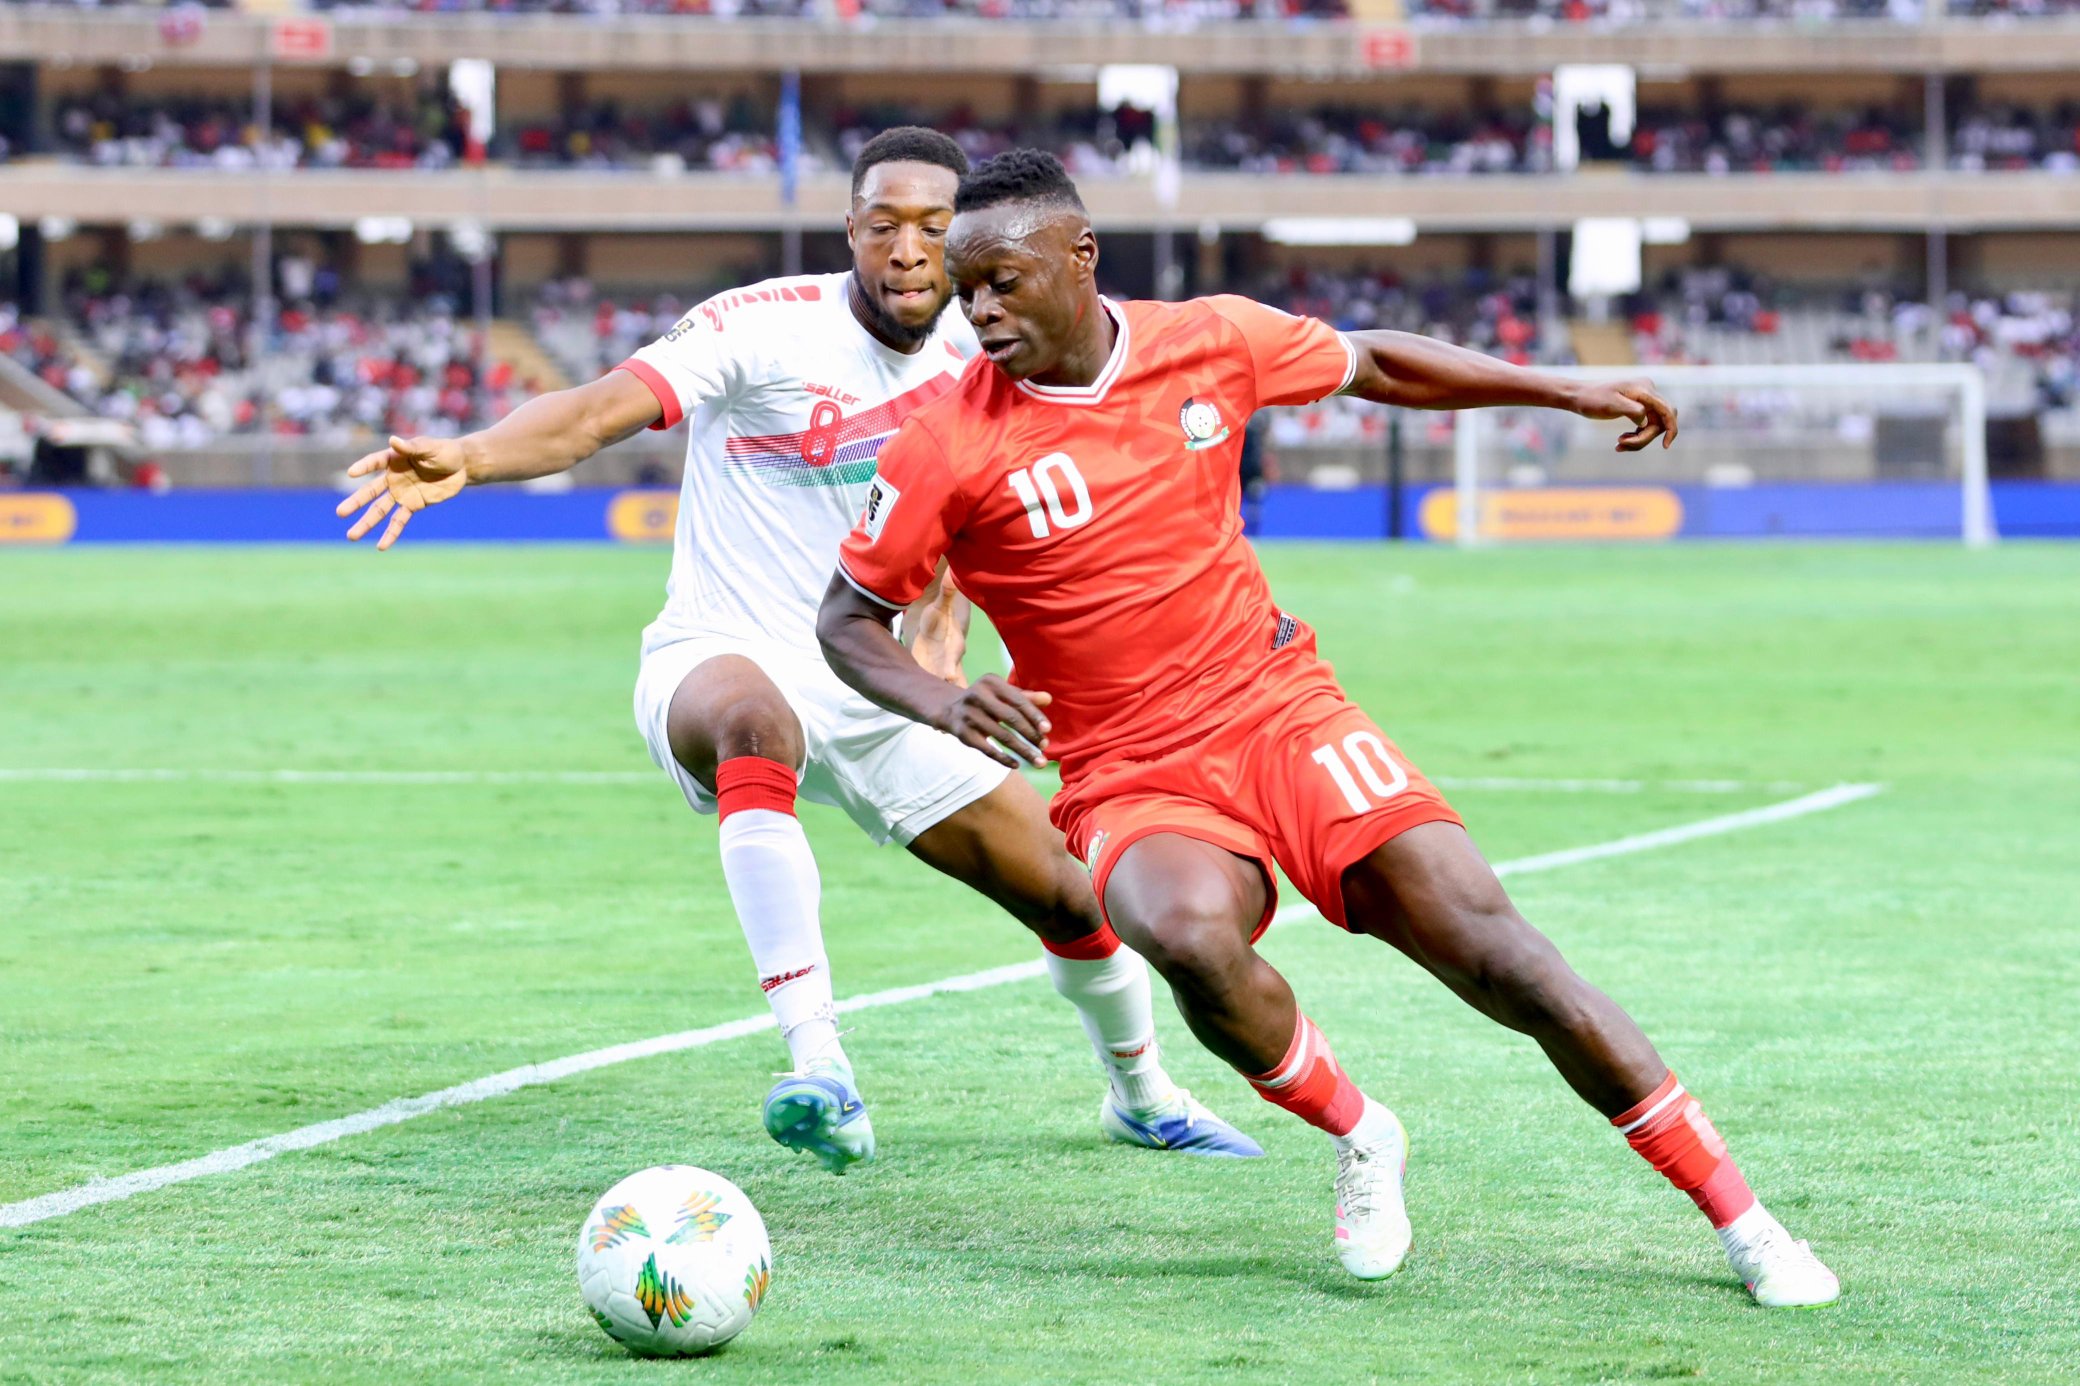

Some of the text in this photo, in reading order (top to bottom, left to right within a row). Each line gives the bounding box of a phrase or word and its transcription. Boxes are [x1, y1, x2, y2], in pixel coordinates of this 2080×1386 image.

[804, 382, 861, 406] saller
[801, 400, 842, 467] 8
[1008, 451, 1093, 539] 10
[1311, 730, 1408, 814] 10
